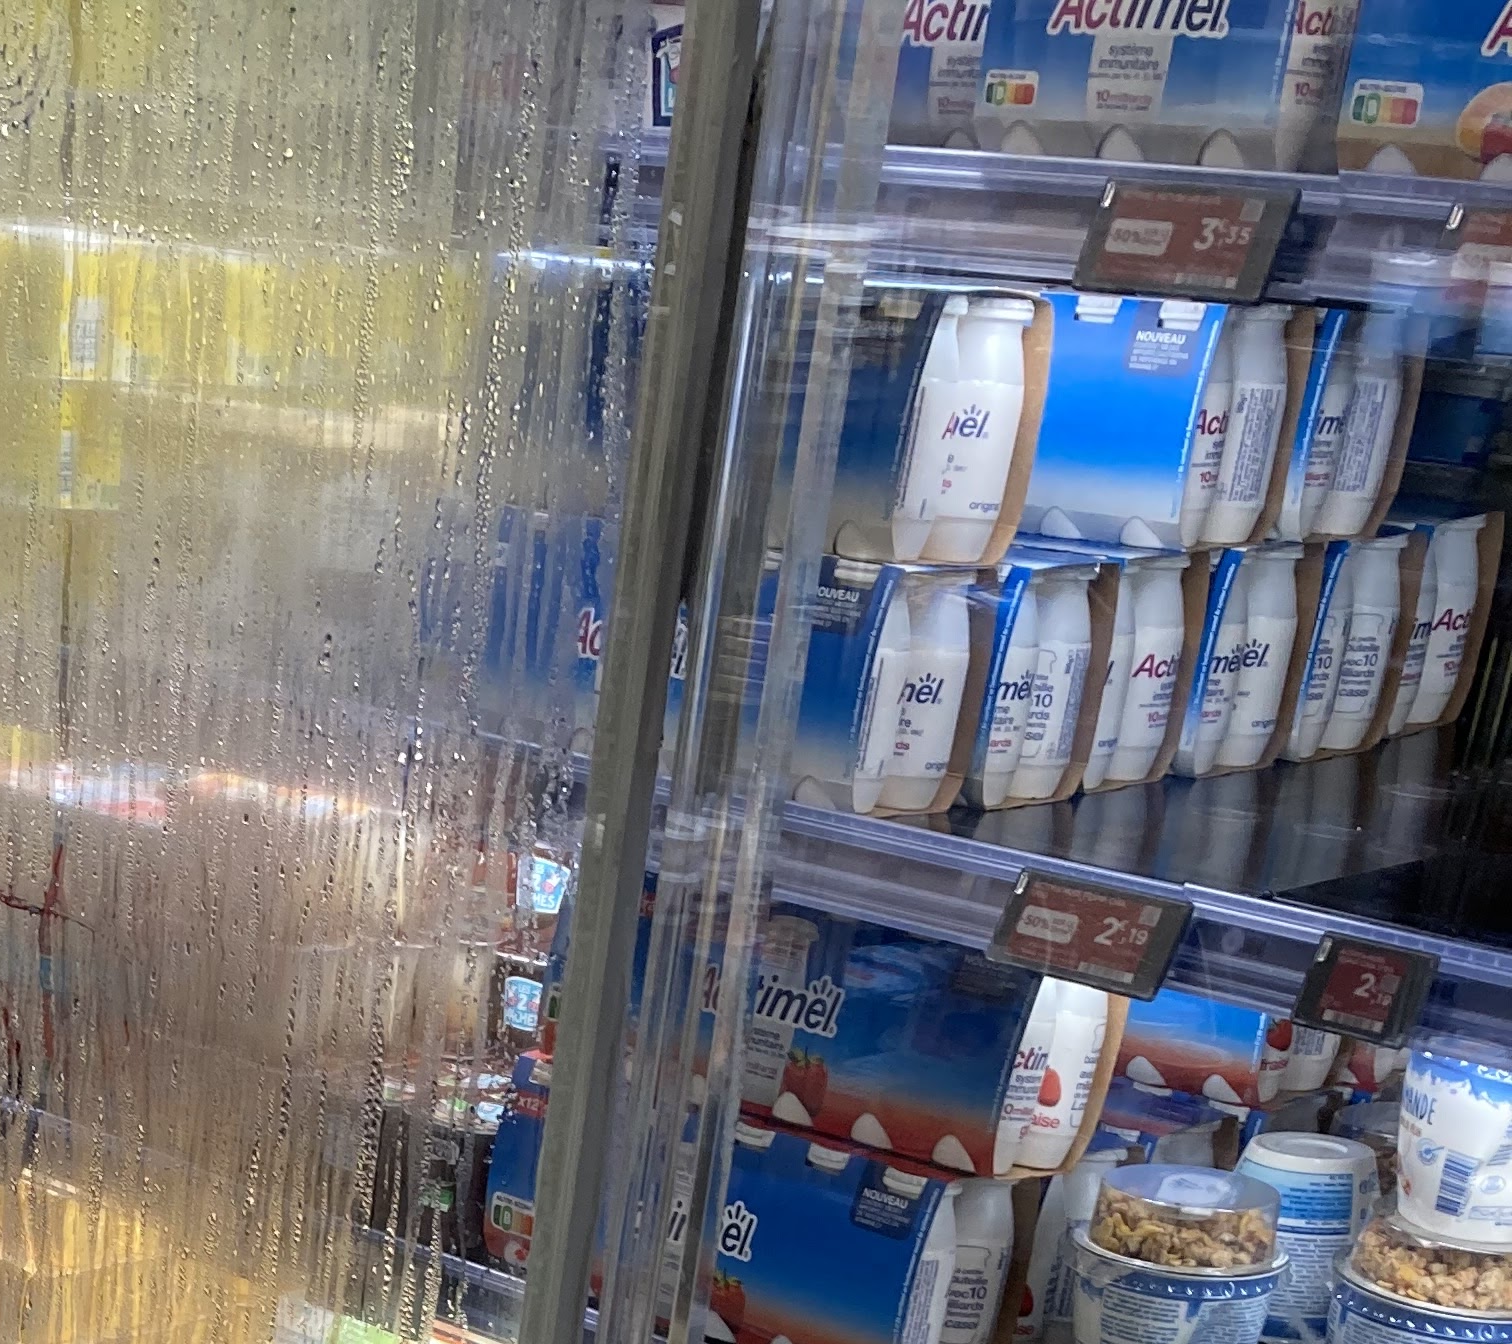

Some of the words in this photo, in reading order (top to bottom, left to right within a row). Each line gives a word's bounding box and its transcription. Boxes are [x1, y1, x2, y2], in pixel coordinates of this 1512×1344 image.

[1135, 330, 1187, 346] NOUVEAU
[816, 584, 861, 604] OUVEAU
[862, 1187, 909, 1209] NOUVEAU
